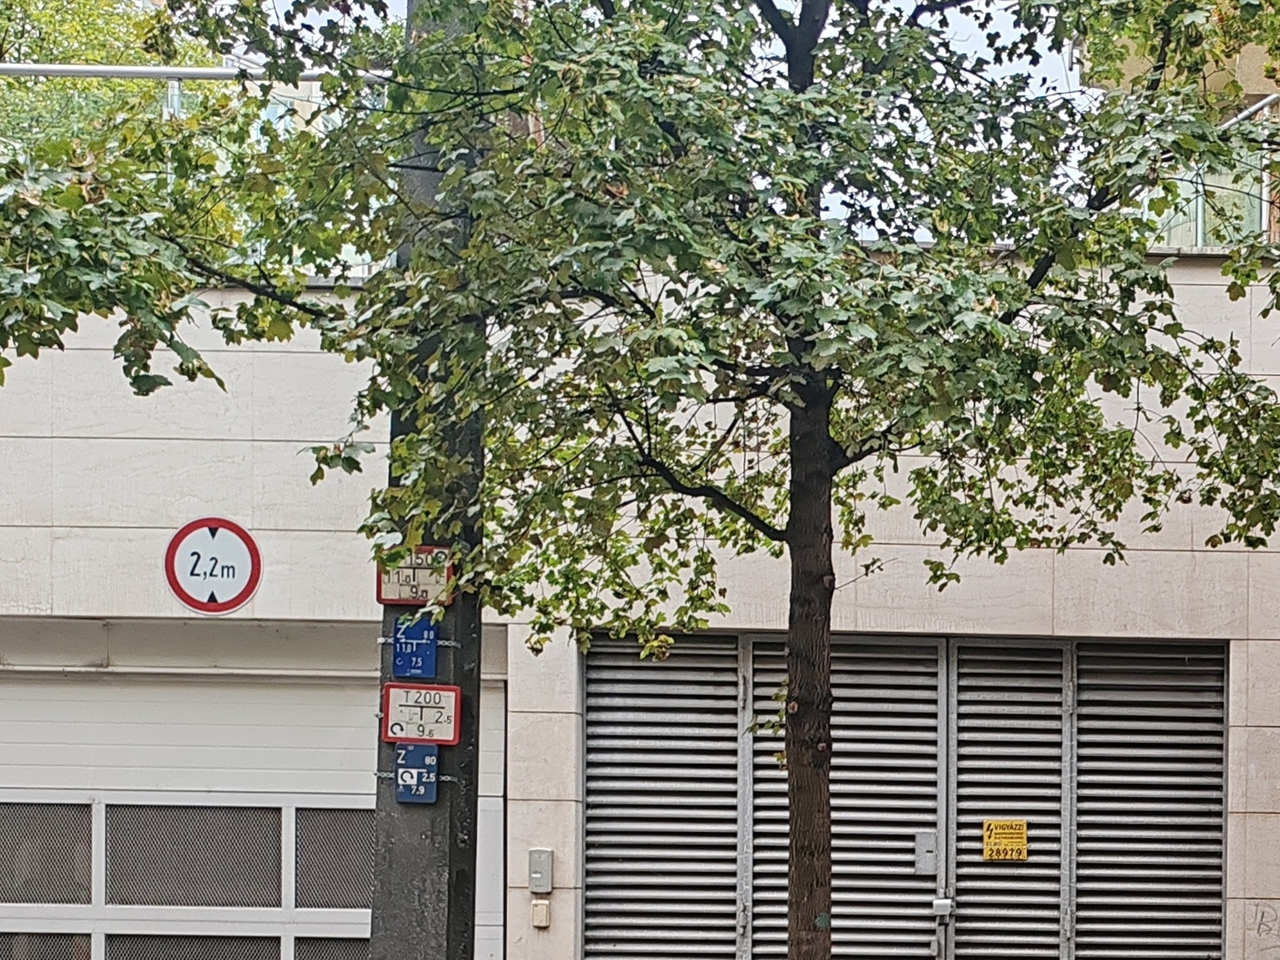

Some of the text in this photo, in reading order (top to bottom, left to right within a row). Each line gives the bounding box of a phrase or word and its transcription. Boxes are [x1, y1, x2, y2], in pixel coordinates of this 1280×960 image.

[397, 749, 406, 764] Z
[424, 756, 437, 765] 80
[988, 847, 1022, 858] 28979
